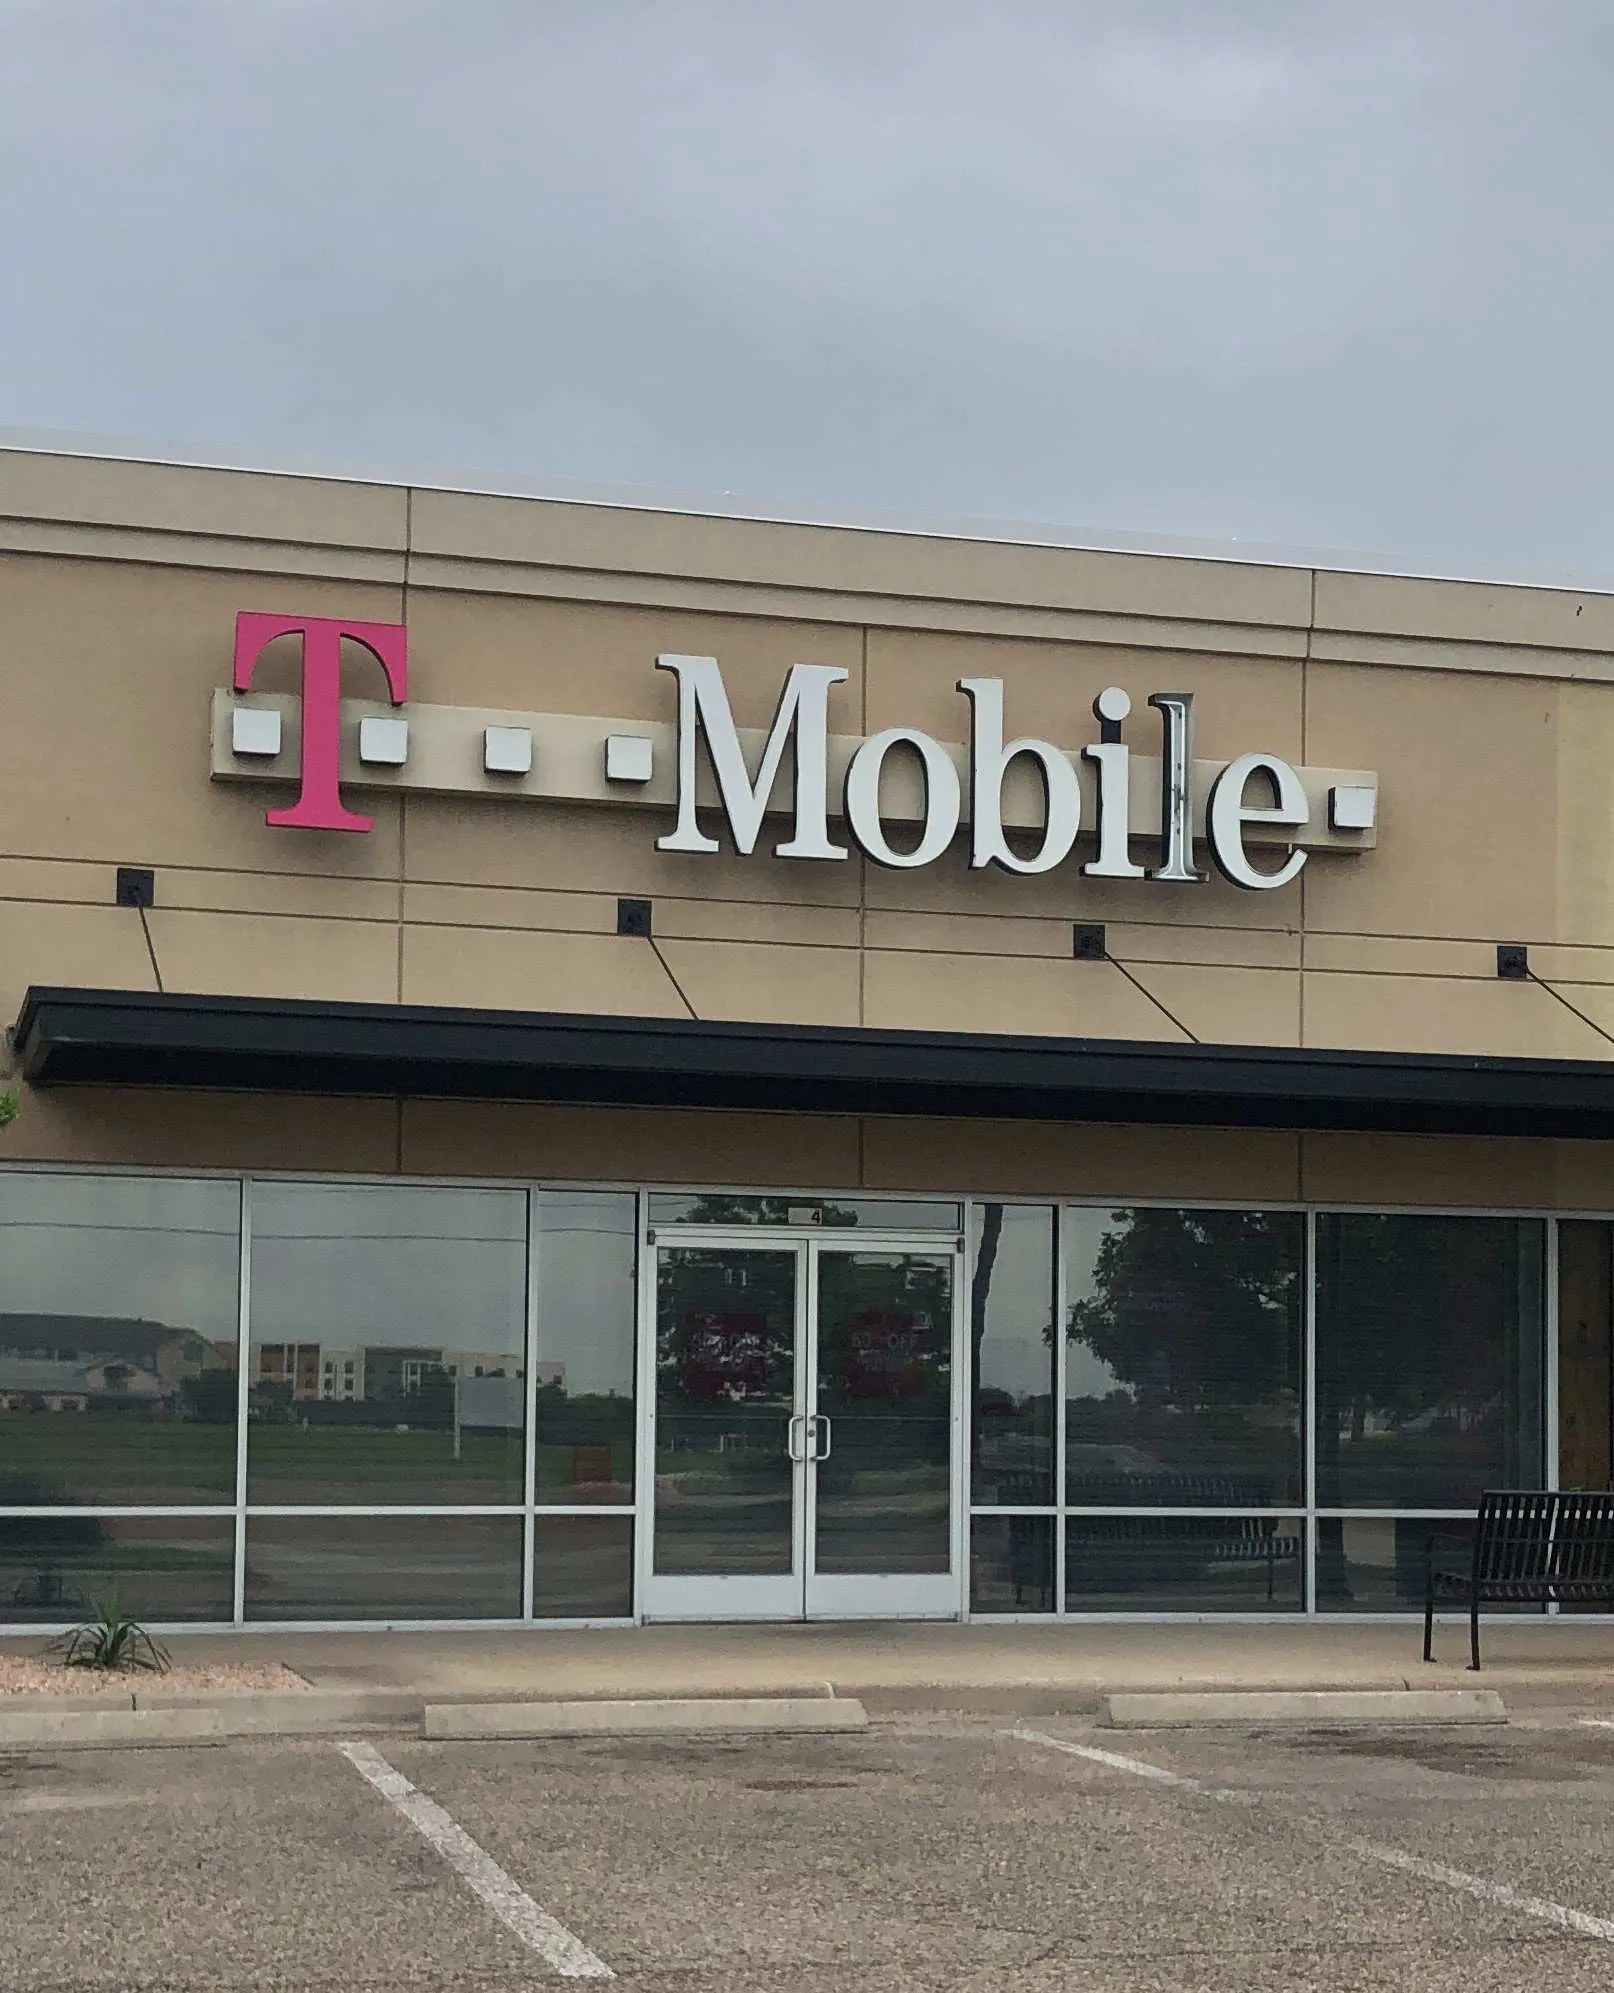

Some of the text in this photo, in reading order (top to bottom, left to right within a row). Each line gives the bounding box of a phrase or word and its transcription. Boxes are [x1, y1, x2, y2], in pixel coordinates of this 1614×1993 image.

[234, 610, 1309, 890] T Mobile
[811, 1209, 821, 1225] 4
